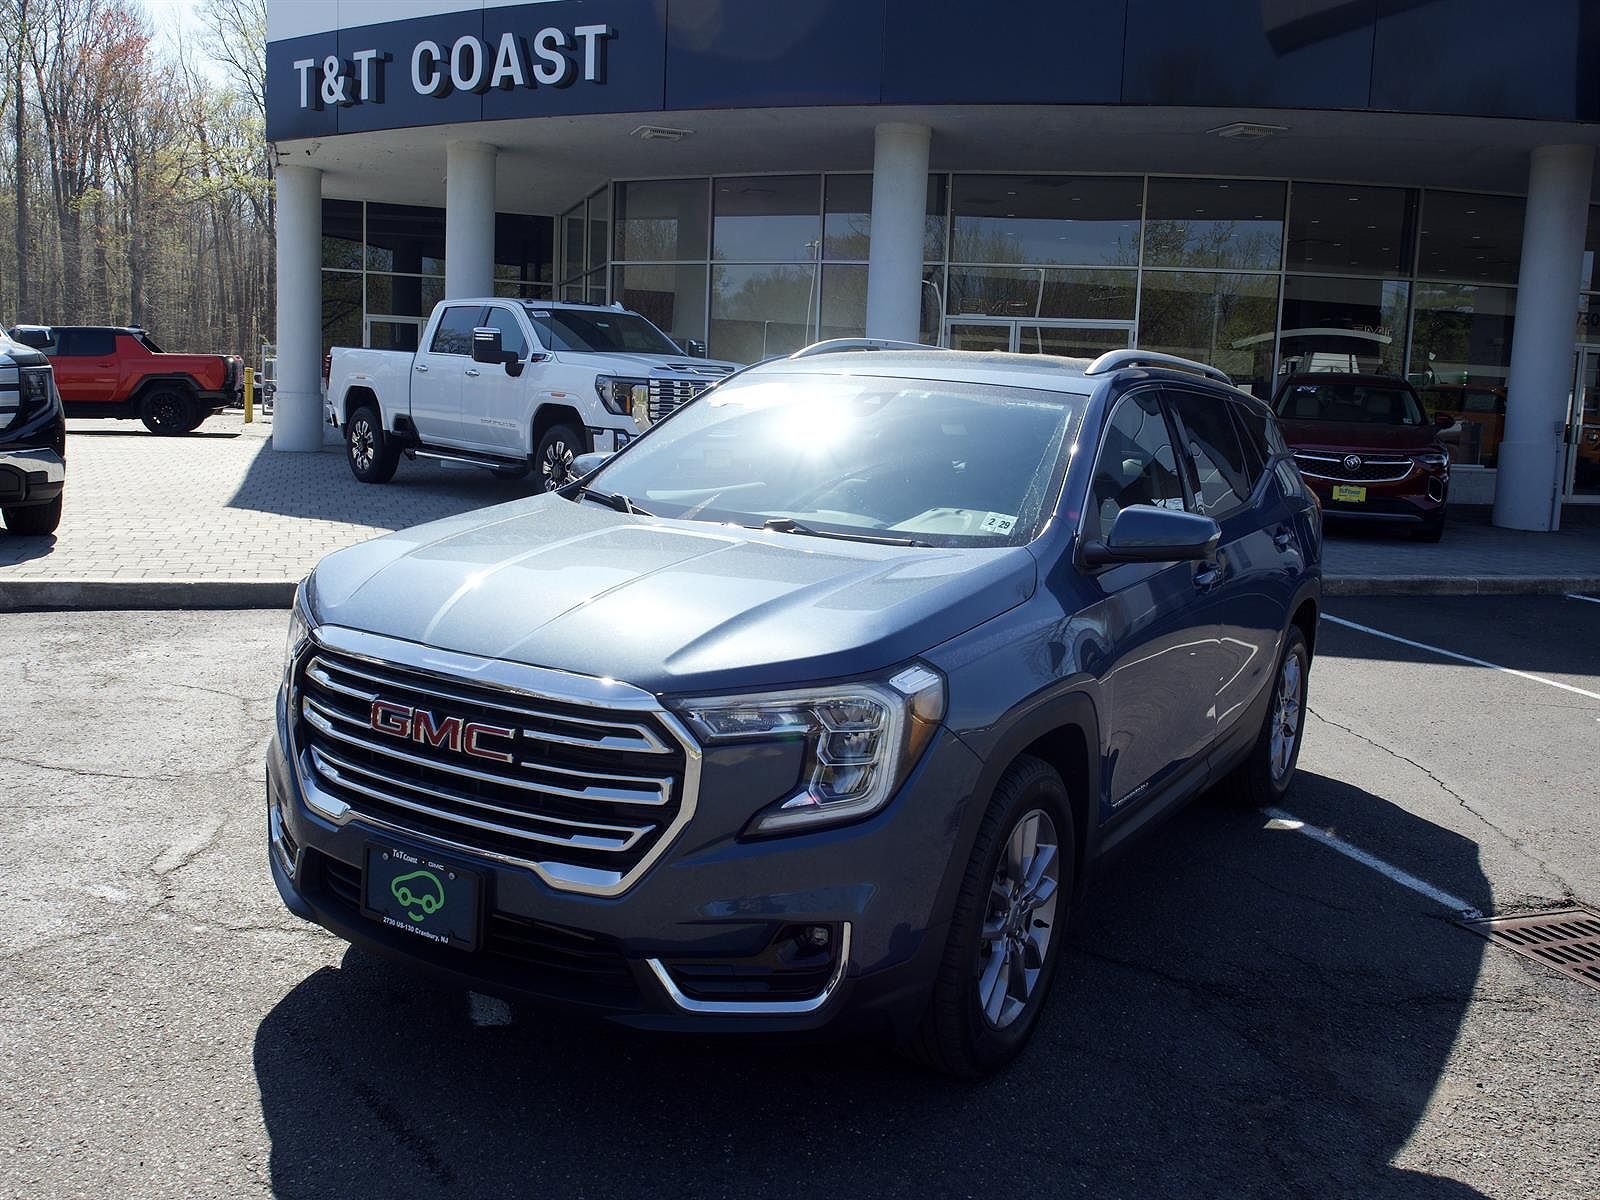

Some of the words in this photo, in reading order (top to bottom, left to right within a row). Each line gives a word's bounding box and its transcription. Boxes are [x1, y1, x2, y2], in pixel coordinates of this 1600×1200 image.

[293, 48, 378, 109] T&T
[411, 24, 608, 97] COAST
[998, 520, 1010, 529] 29
[371, 699, 515, 764] GMC
[383, 916, 396, 926] 2730
[440, 936, 449, 944] NJ
